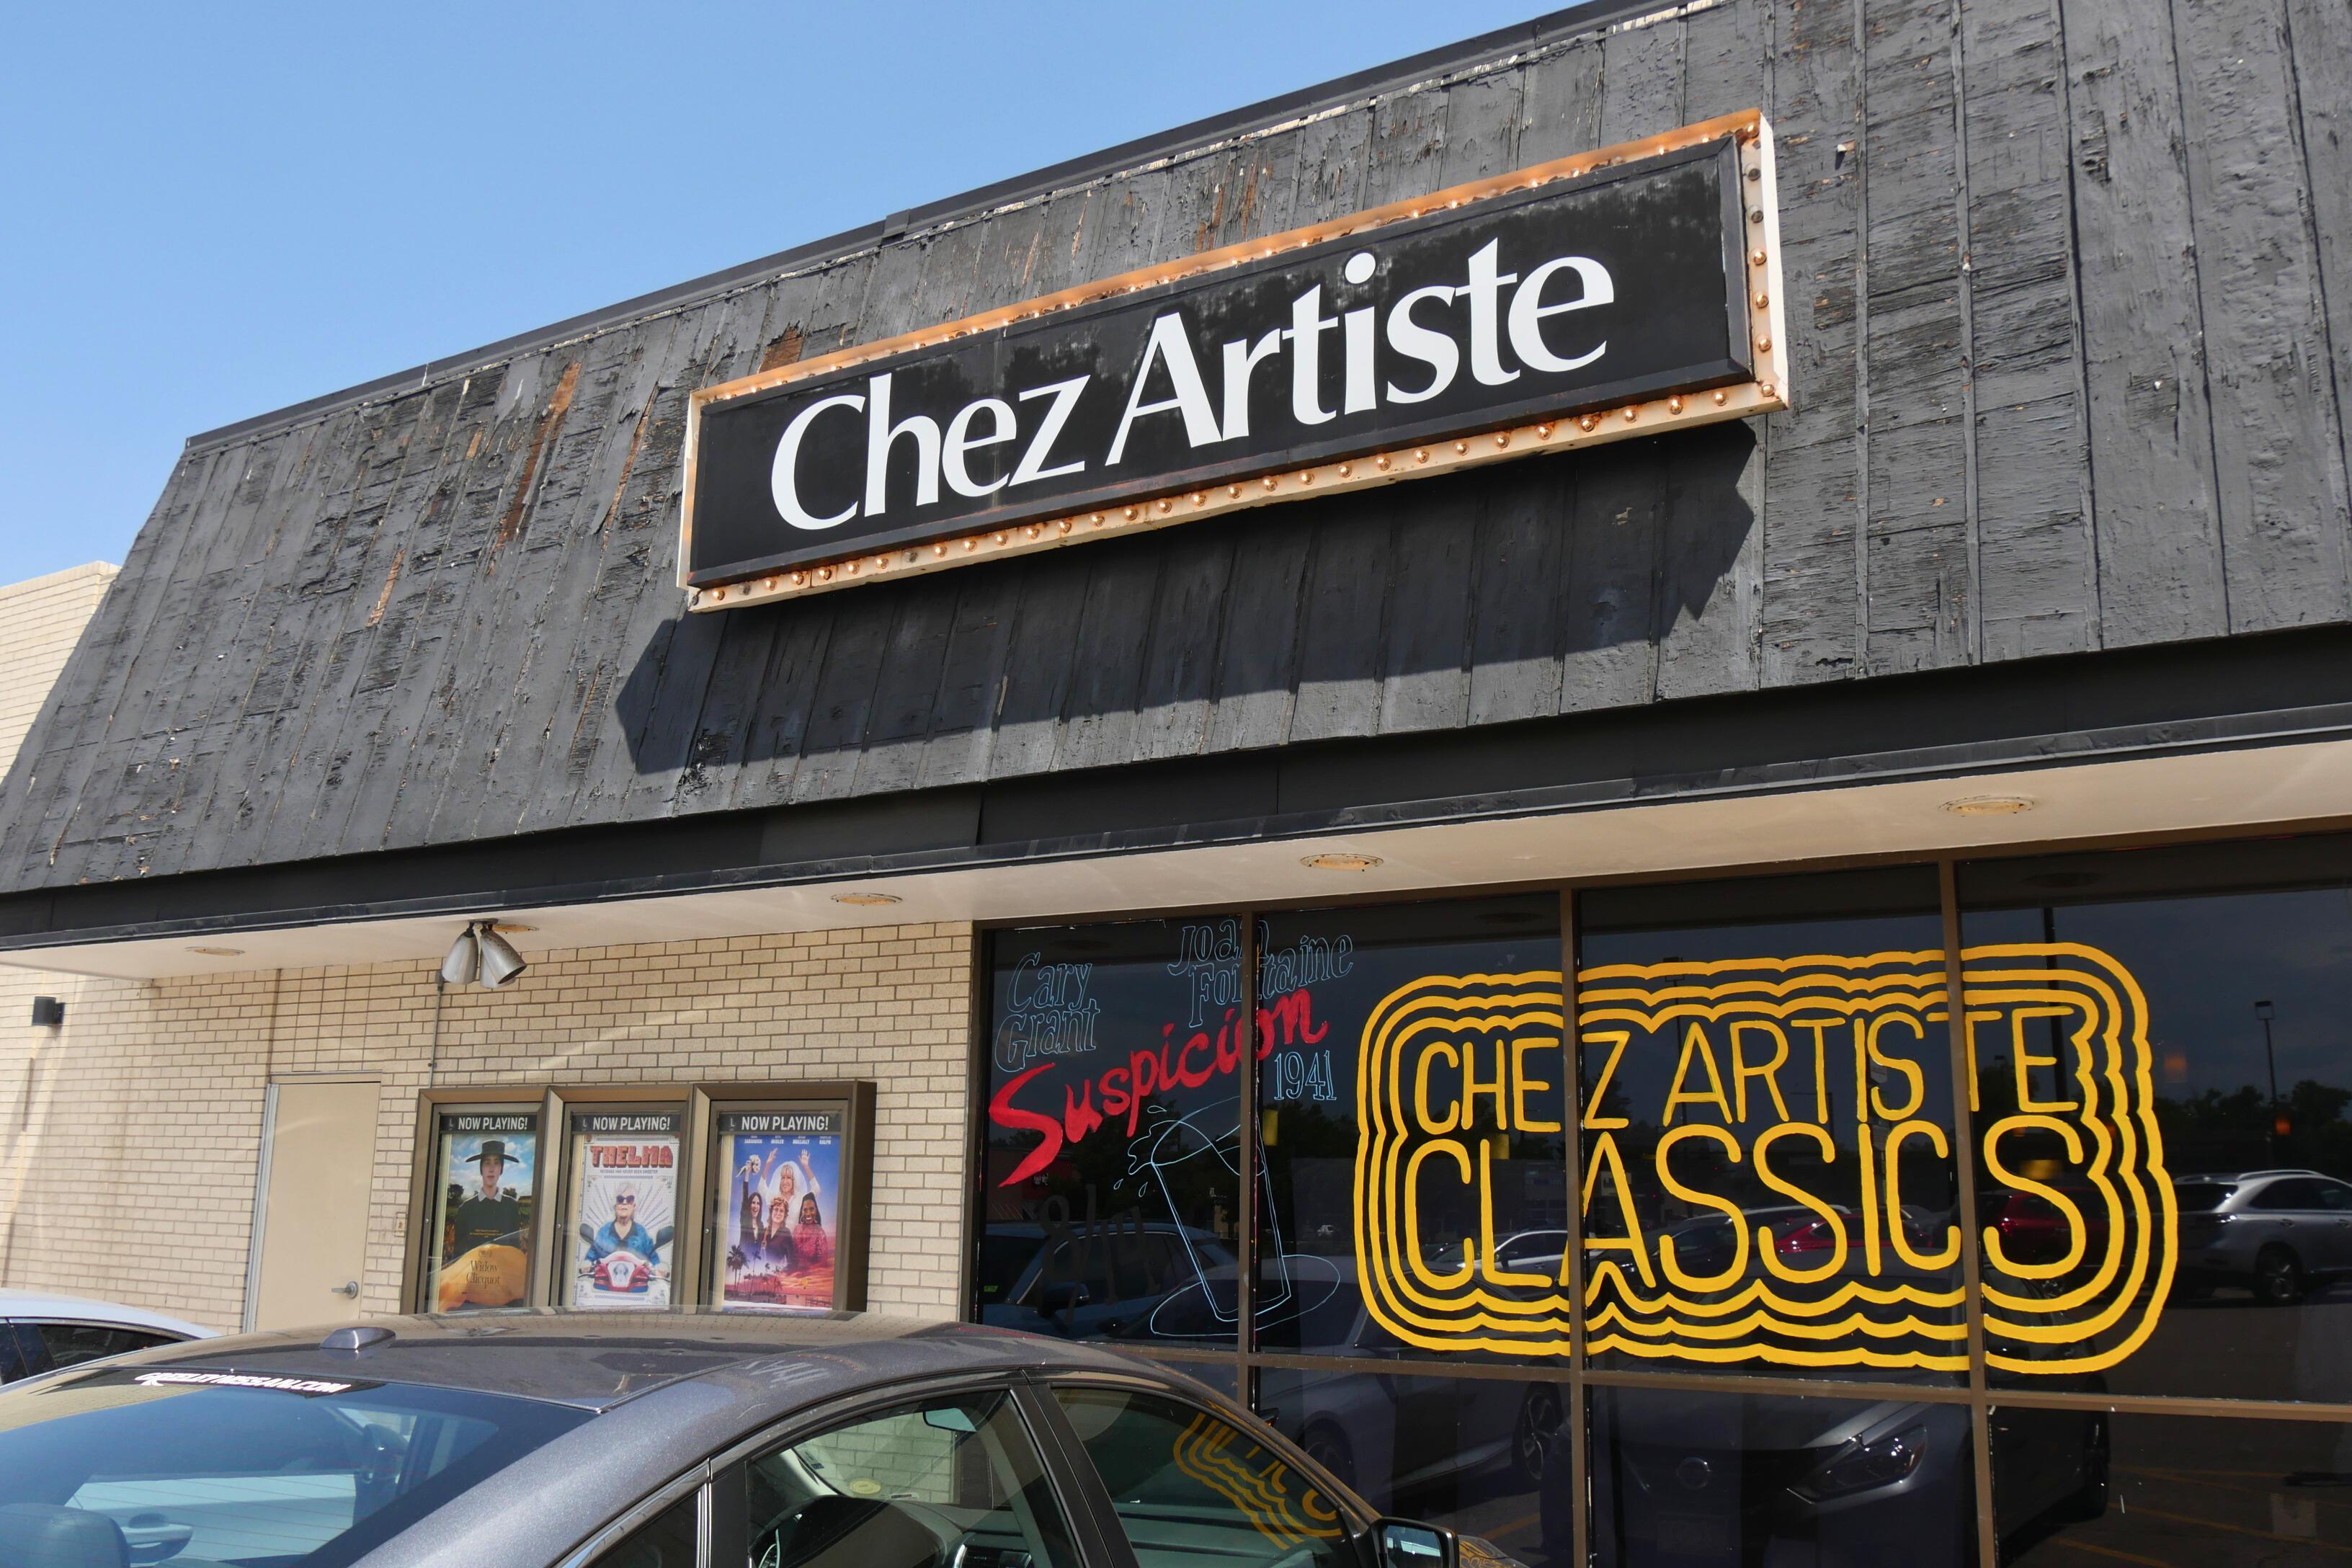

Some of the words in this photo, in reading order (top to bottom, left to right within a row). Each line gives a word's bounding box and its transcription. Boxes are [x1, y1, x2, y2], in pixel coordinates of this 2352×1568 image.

[771, 373, 1091, 530] Chez
[1105, 237, 1615, 466] Artiste
[1007, 951, 1093, 1013] Cary
[994, 998, 1101, 1073] Grant
[989, 988, 1329, 1188] Suspicion
[1273, 1049, 1337, 1101] 1941
[1415, 1030, 1631, 1136] CHEZ
[1662, 1006, 2079, 1129] ARTISTE
[458, 1117, 481, 1130] NOW
[482, 1117, 528, 1130] PLAYING!
[592, 1117, 618, 1131] NOW
[620, 1116, 670, 1131] PLAYING!
[741, 1116, 770, 1131] NOW
[772, 1116, 829, 1131] PLAYING!
[590, 1145, 674, 1168] THELMA
[1404, 1115, 2087, 1293] CLASSICS
[466, 1272, 500, 1289] Clicquot
[470, 1260, 497, 1272] Widow
